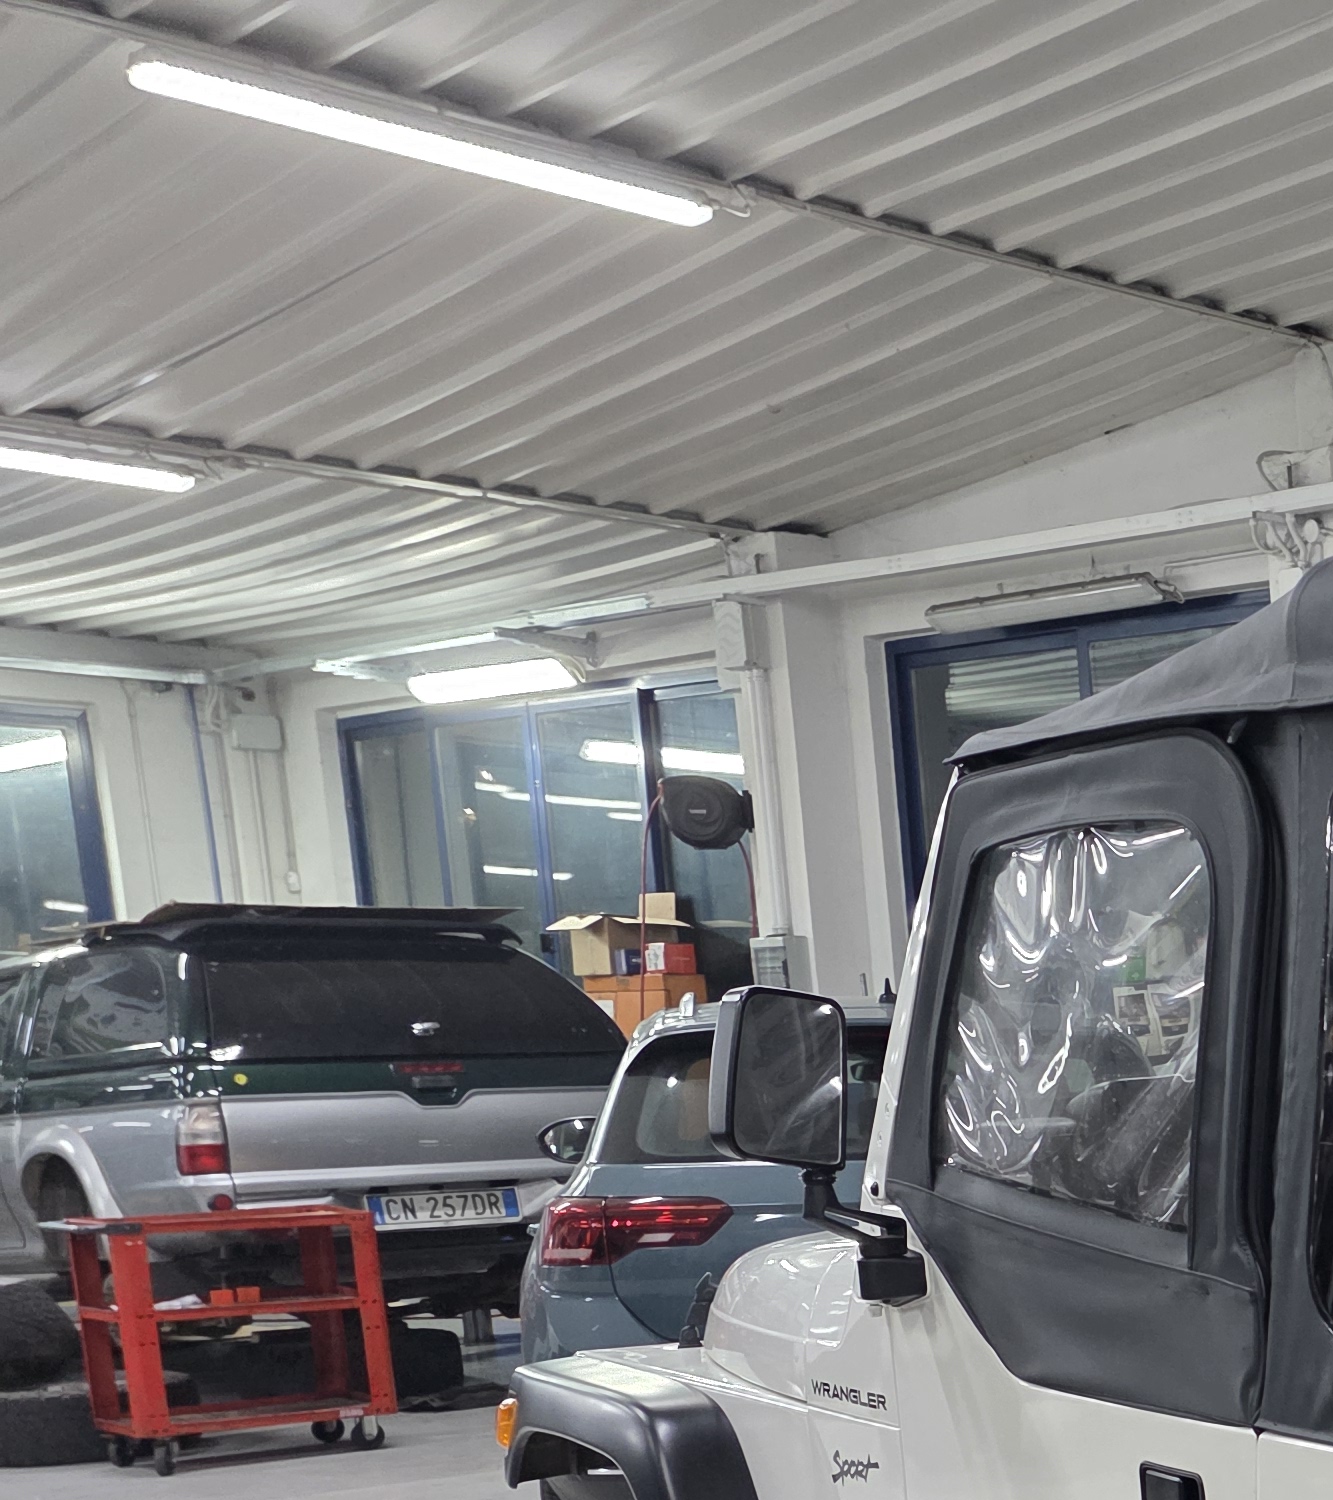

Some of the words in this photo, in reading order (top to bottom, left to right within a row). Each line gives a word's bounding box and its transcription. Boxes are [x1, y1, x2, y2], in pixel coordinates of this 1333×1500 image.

[385, 1197, 418, 1221] CN
[425, 1192, 502, 1219] 257DR
[811, 1378, 888, 1412] WRANGLER
